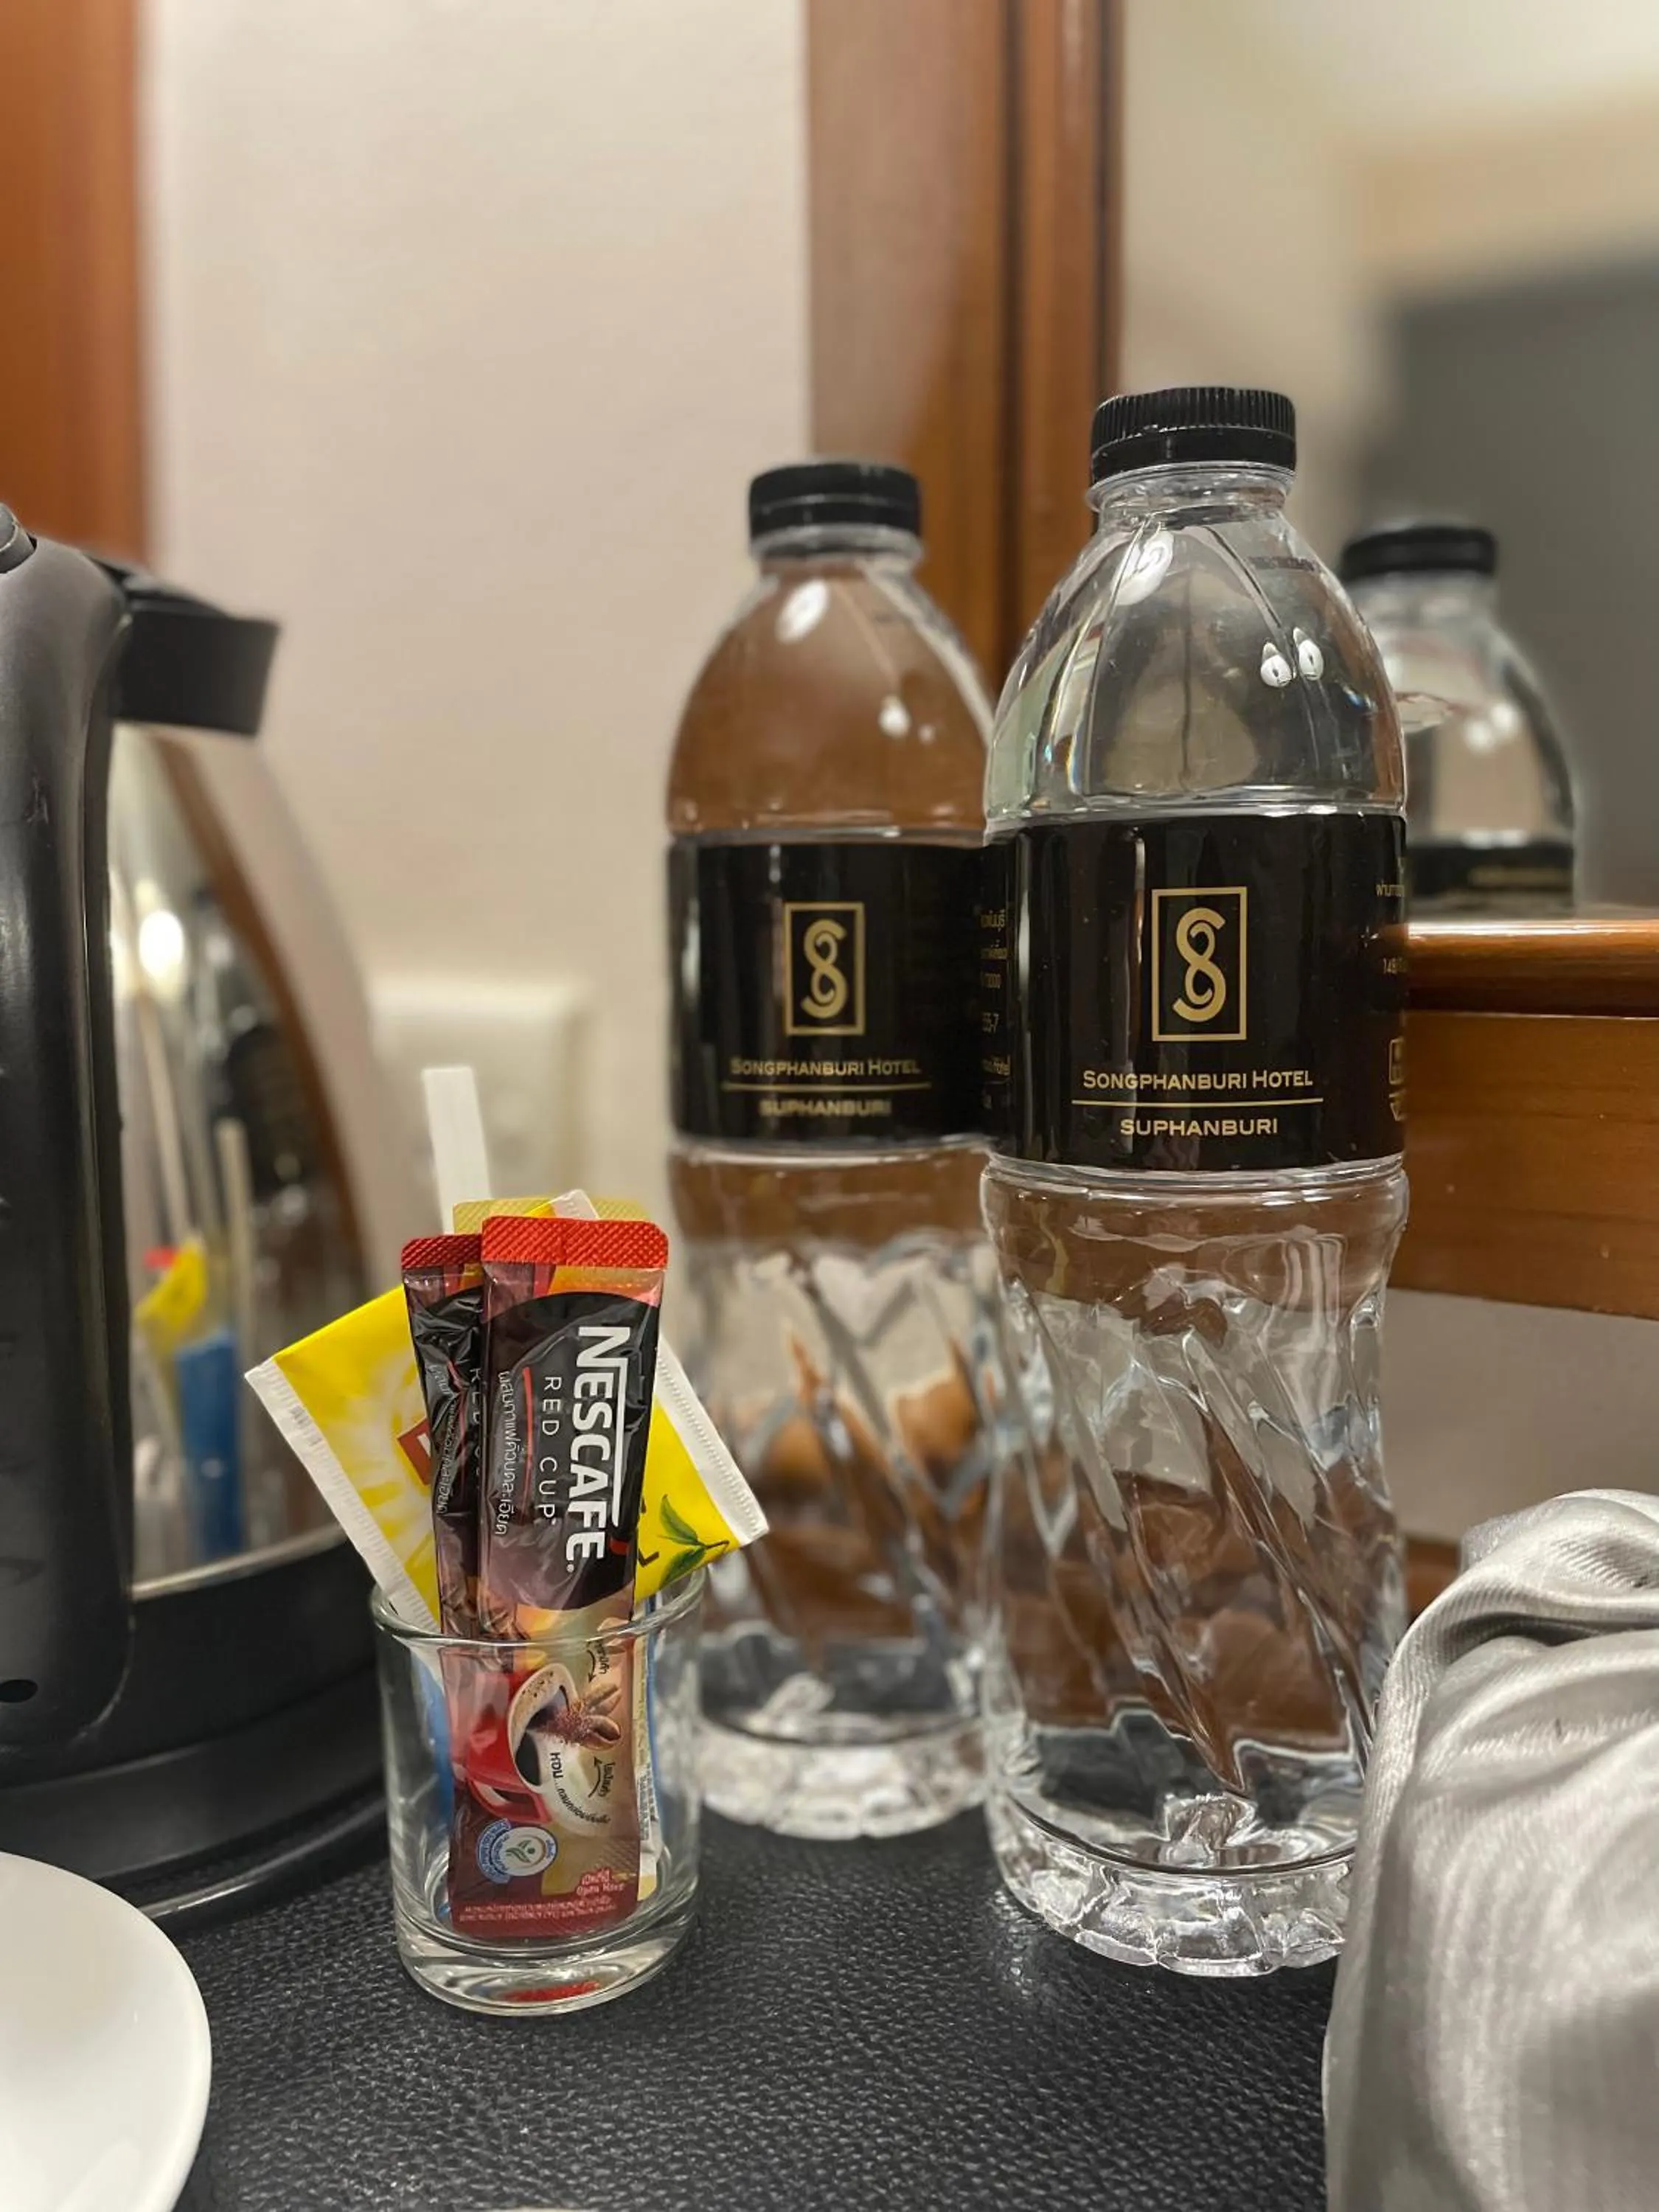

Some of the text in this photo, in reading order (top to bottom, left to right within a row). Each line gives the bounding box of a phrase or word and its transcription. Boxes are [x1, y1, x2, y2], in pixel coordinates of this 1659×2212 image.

[730, 1057, 921, 1077] SONGPHANBURI HOTEL
[1082, 1070, 1313, 1091] SONGPHANBURI HOTEL
[759, 1099, 892, 1117] SUPHANBURI
[1120, 1118, 1278, 1136] SUPHANBURI
[534, 1376, 560, 1519] RED CUP
